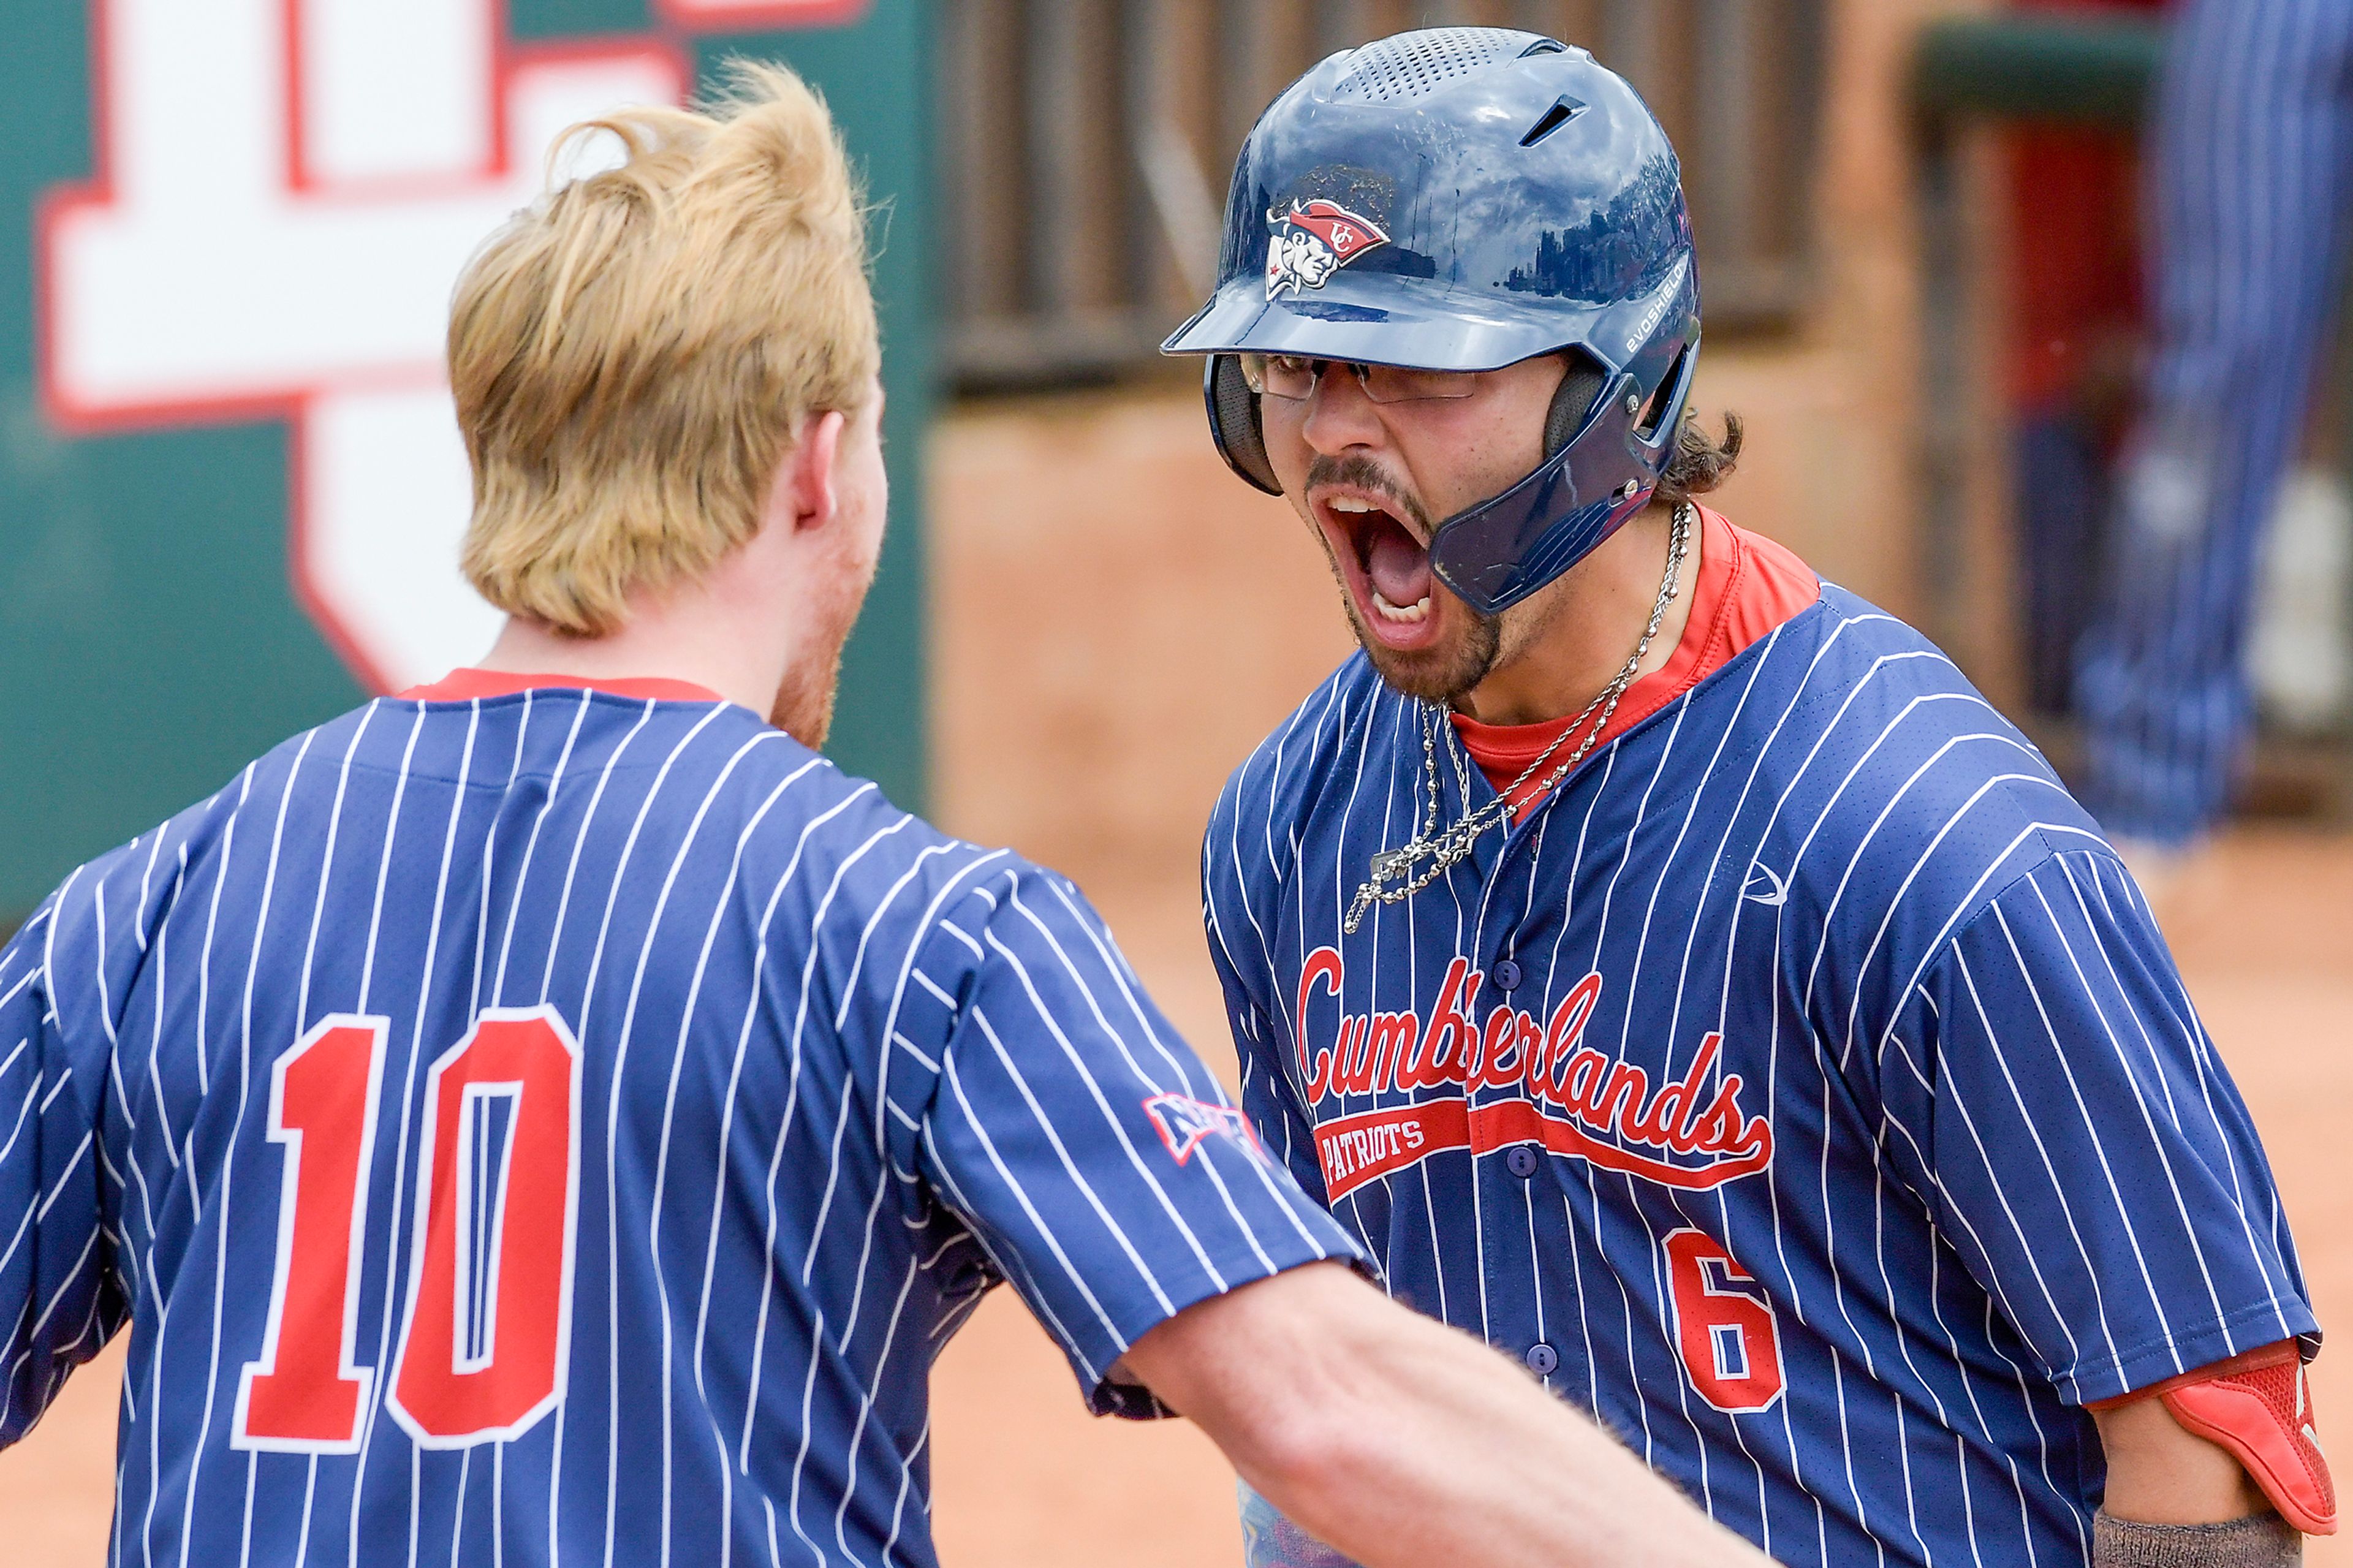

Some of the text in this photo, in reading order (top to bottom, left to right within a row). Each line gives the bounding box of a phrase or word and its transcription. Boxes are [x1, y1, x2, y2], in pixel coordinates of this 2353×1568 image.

[1330, 222, 1353, 252] UC
[1297, 945, 1773, 1156] Cumberlands
[230, 1003, 584, 1455] 10
[1322, 1121, 1425, 1186] PATRIOTS
[1661, 1227, 1787, 1414] 6
